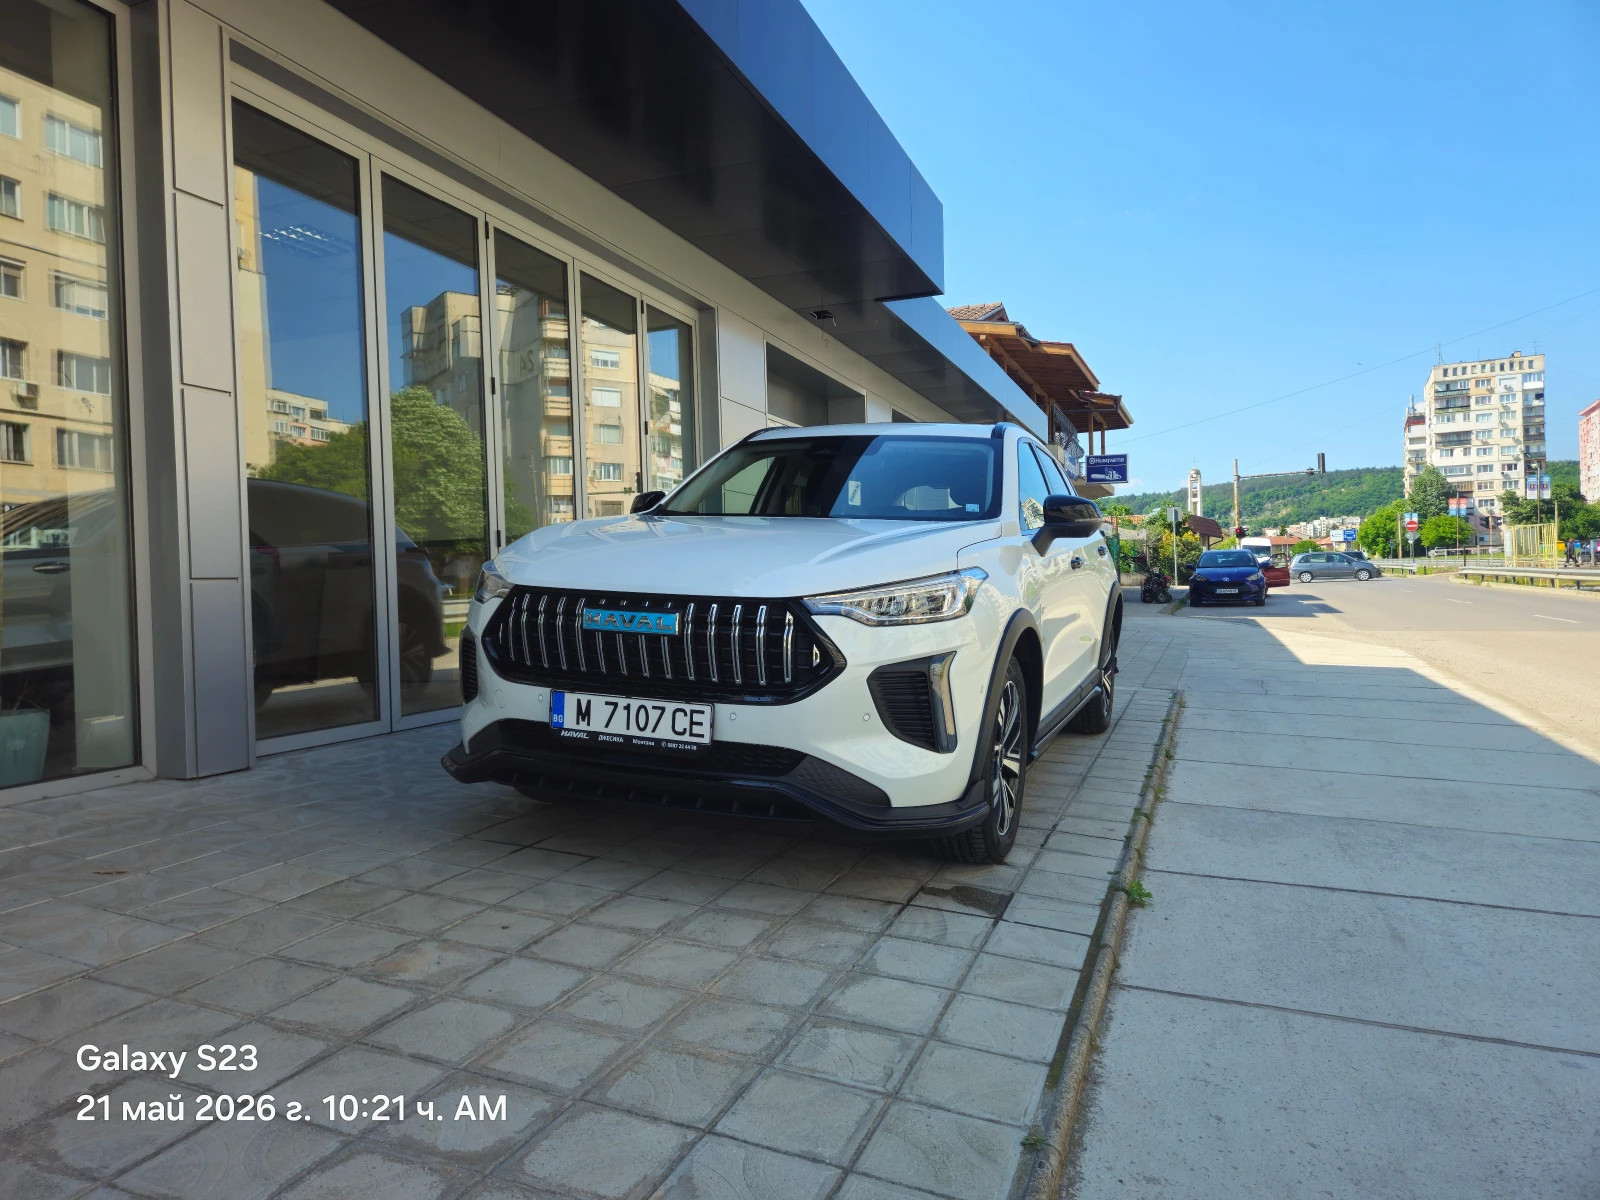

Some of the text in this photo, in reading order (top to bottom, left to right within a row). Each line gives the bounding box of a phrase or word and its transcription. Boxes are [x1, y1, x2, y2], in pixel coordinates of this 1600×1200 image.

[586, 612, 672, 631] HAVAL
[553, 713, 564, 723] BG
[575, 698, 705, 739] M 7107 CE
[560, 729, 590, 739] HAVAL
